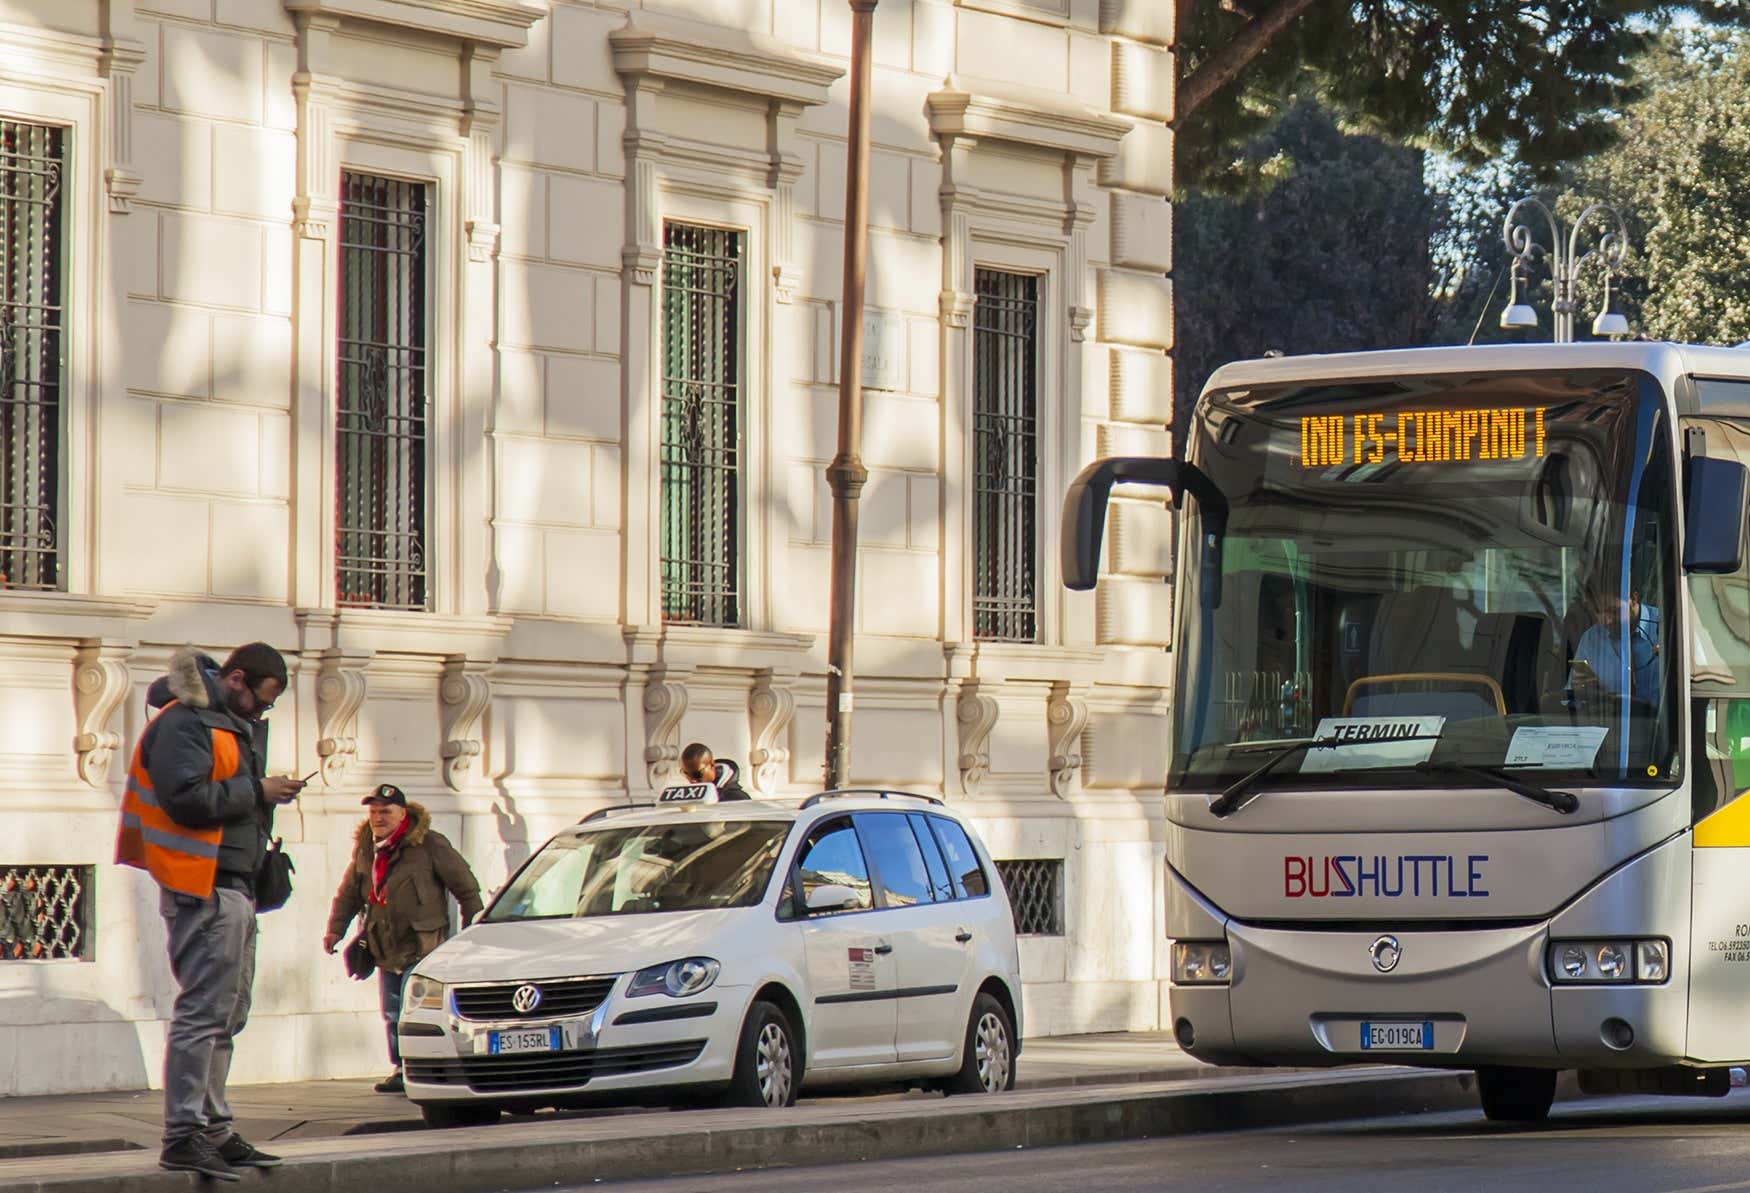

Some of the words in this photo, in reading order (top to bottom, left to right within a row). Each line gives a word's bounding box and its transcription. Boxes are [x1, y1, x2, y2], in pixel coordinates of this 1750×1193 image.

[1353, 408, 1526, 464] FS-CIAMPINO
[1333, 723, 1421, 744] TERMINI
[664, 786, 705, 800] TAXI
[1724, 952, 1737, 962] FAX
